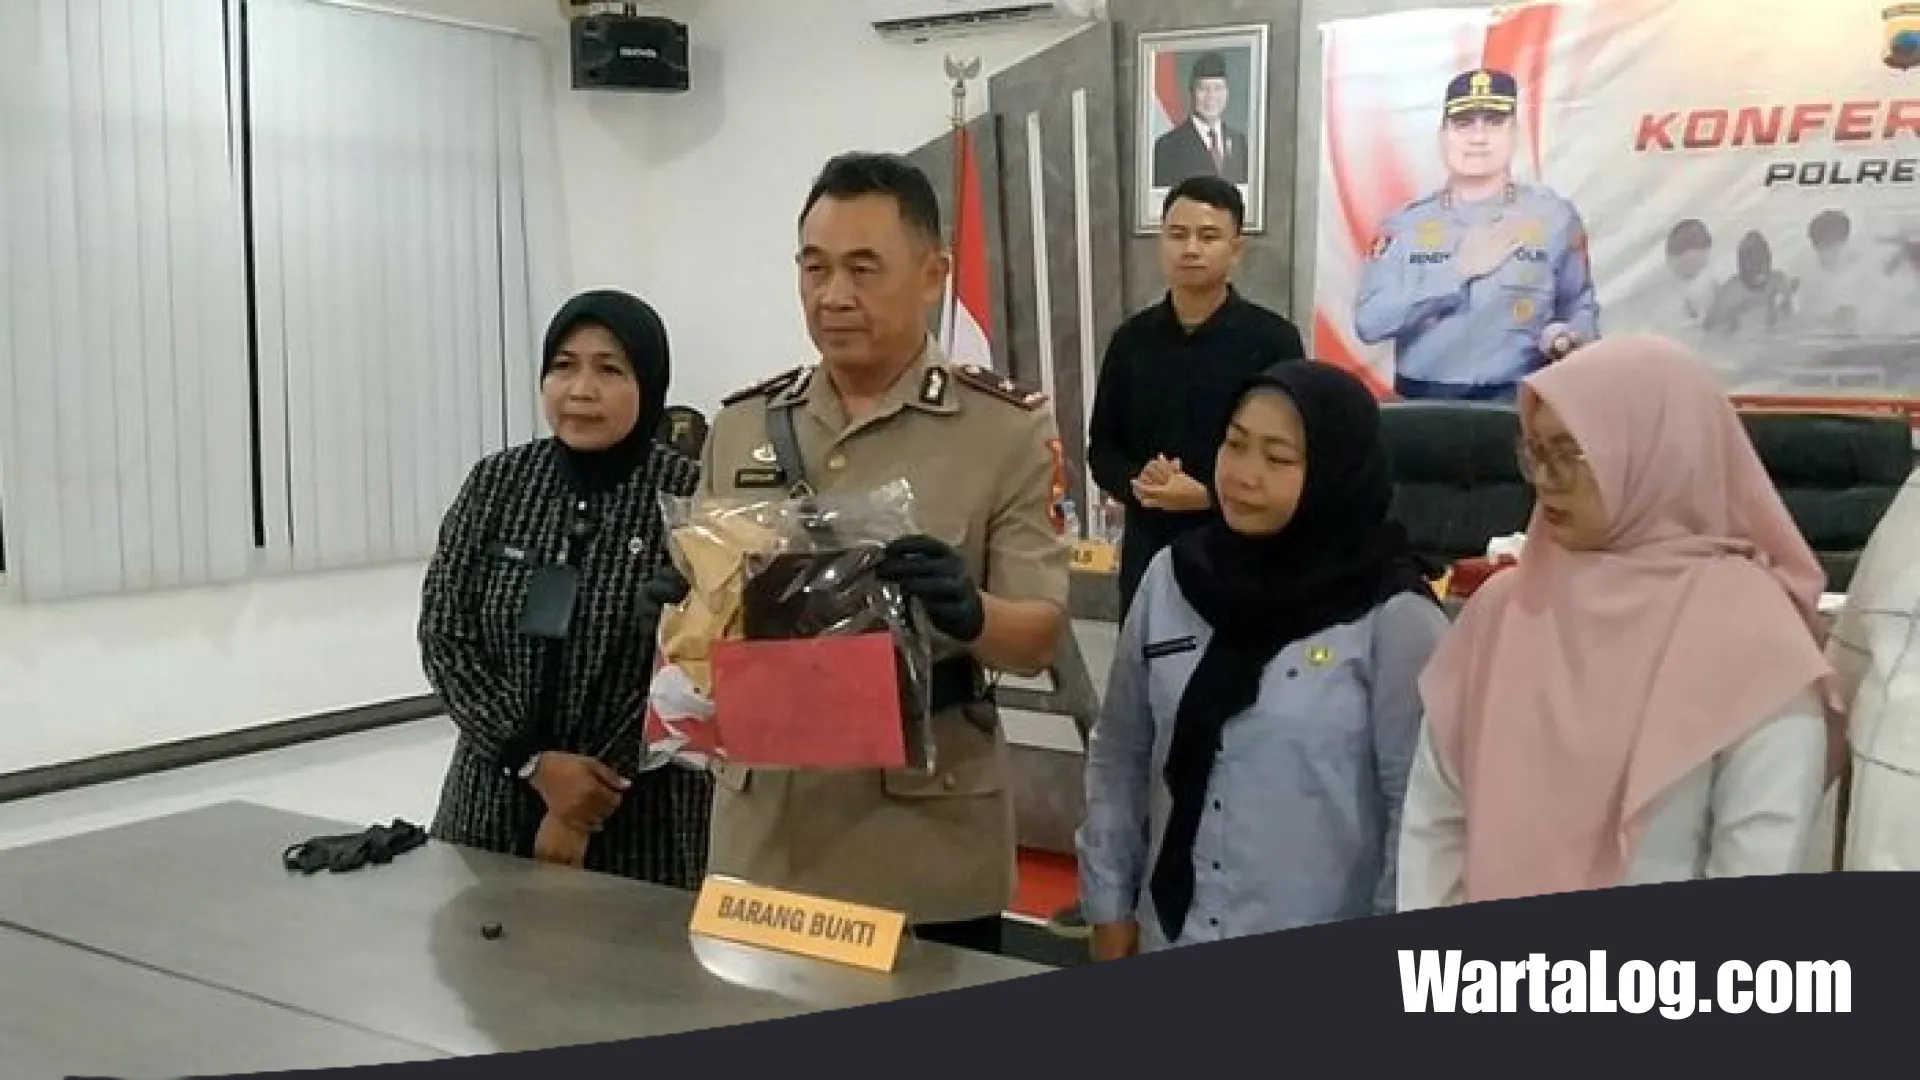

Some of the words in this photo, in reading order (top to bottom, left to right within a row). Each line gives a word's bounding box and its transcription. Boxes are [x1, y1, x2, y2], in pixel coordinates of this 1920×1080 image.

[1635, 100, 1920, 151] KONFER
[1764, 158, 1919, 186] POLRE
[718, 895, 805, 933] BARANG
[809, 911, 876, 947] BUKTI
